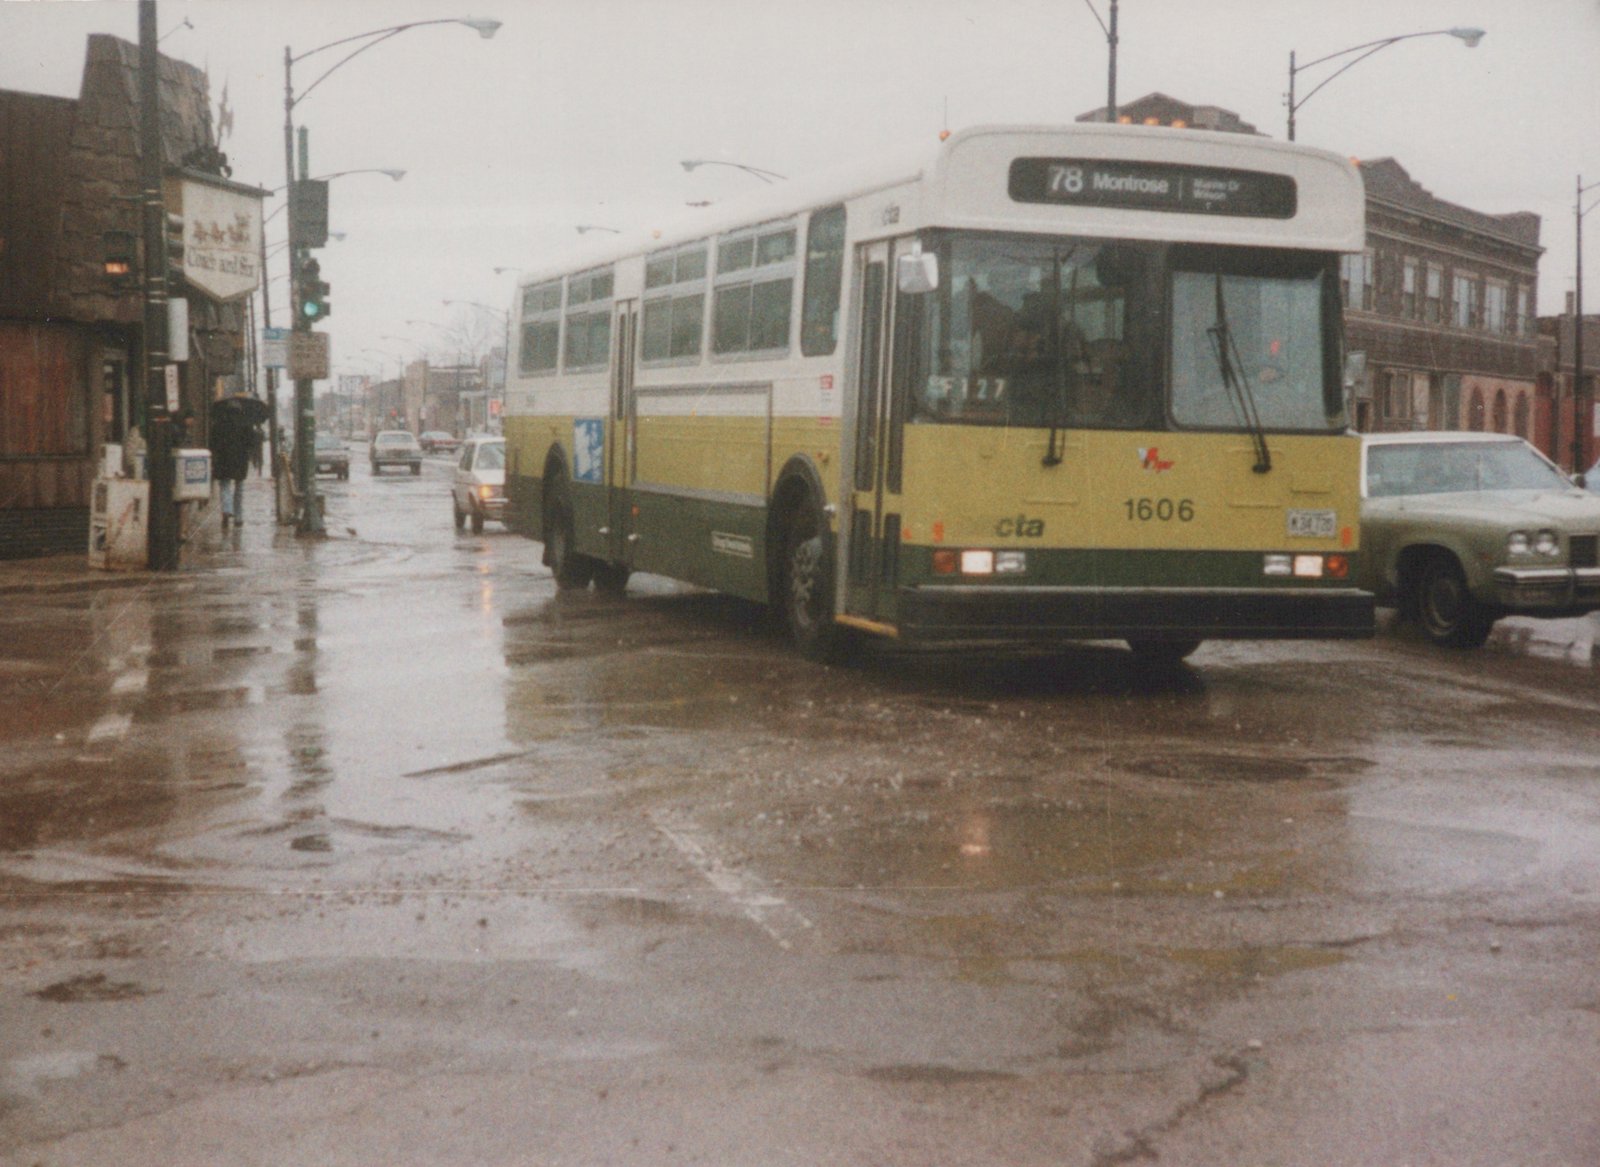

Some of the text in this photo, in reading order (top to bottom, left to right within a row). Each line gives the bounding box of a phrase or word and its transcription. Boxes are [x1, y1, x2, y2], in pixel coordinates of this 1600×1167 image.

[1049, 166, 1168, 194] 78 Montrose
[1125, 499, 1194, 522] 1606
[996, 514, 1045, 538] cta
